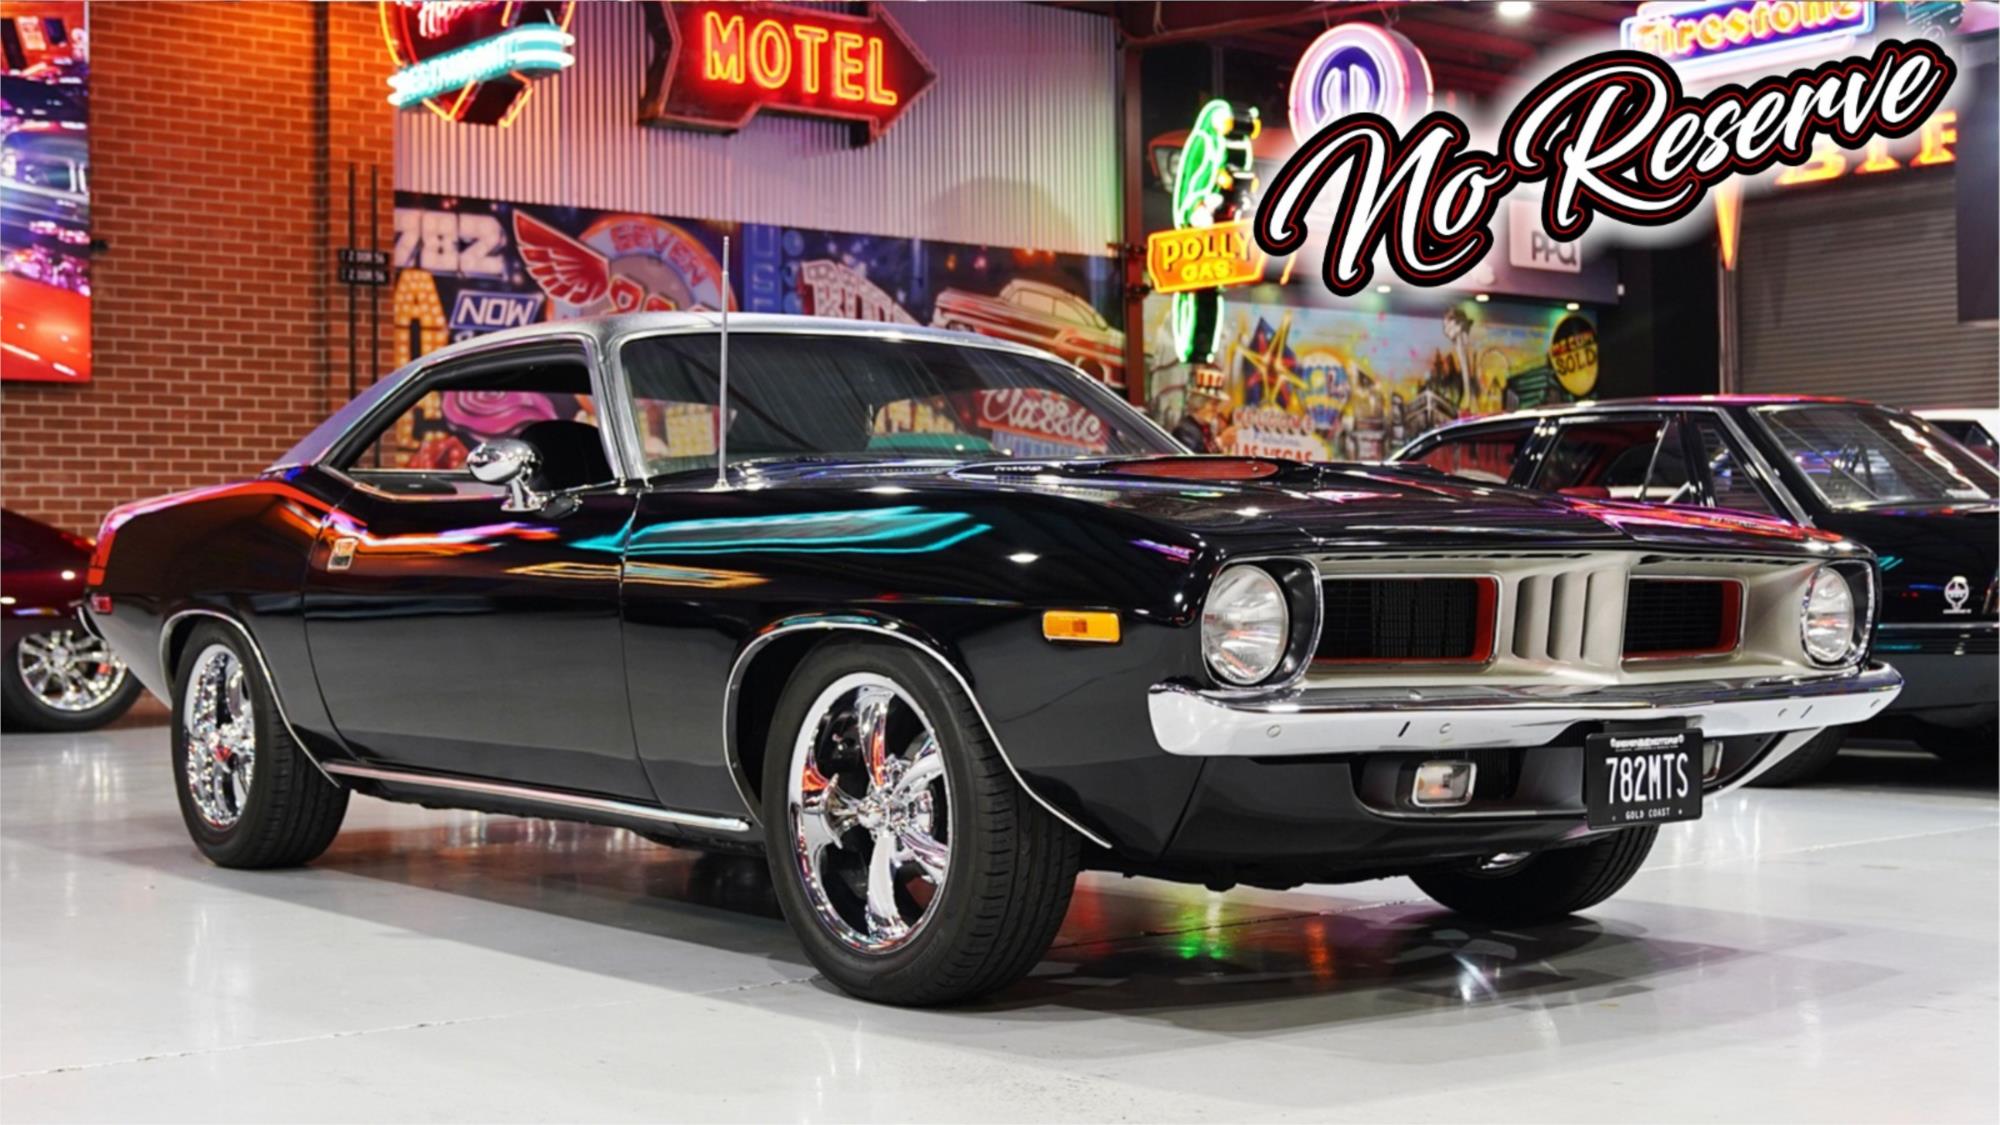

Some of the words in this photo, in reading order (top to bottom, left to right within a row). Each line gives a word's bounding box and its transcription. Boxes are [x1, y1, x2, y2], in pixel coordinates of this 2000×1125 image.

[704, 10, 898, 106] MOTEL
[393, 208, 507, 280] 782
[610, 222, 708, 287] SEVEN
[1161, 232, 1251, 271] POLLY
[1181, 260, 1230, 282] GAS
[457, 297, 534, 327] NOW
[1555, 347, 1598, 376] SOLD
[979, 387, 1102, 443] Classic
[1605, 752, 1689, 805] 782MTS
[1625, 810, 1645, 821] GOLD
[1648, 806, 1671, 819] COAST
